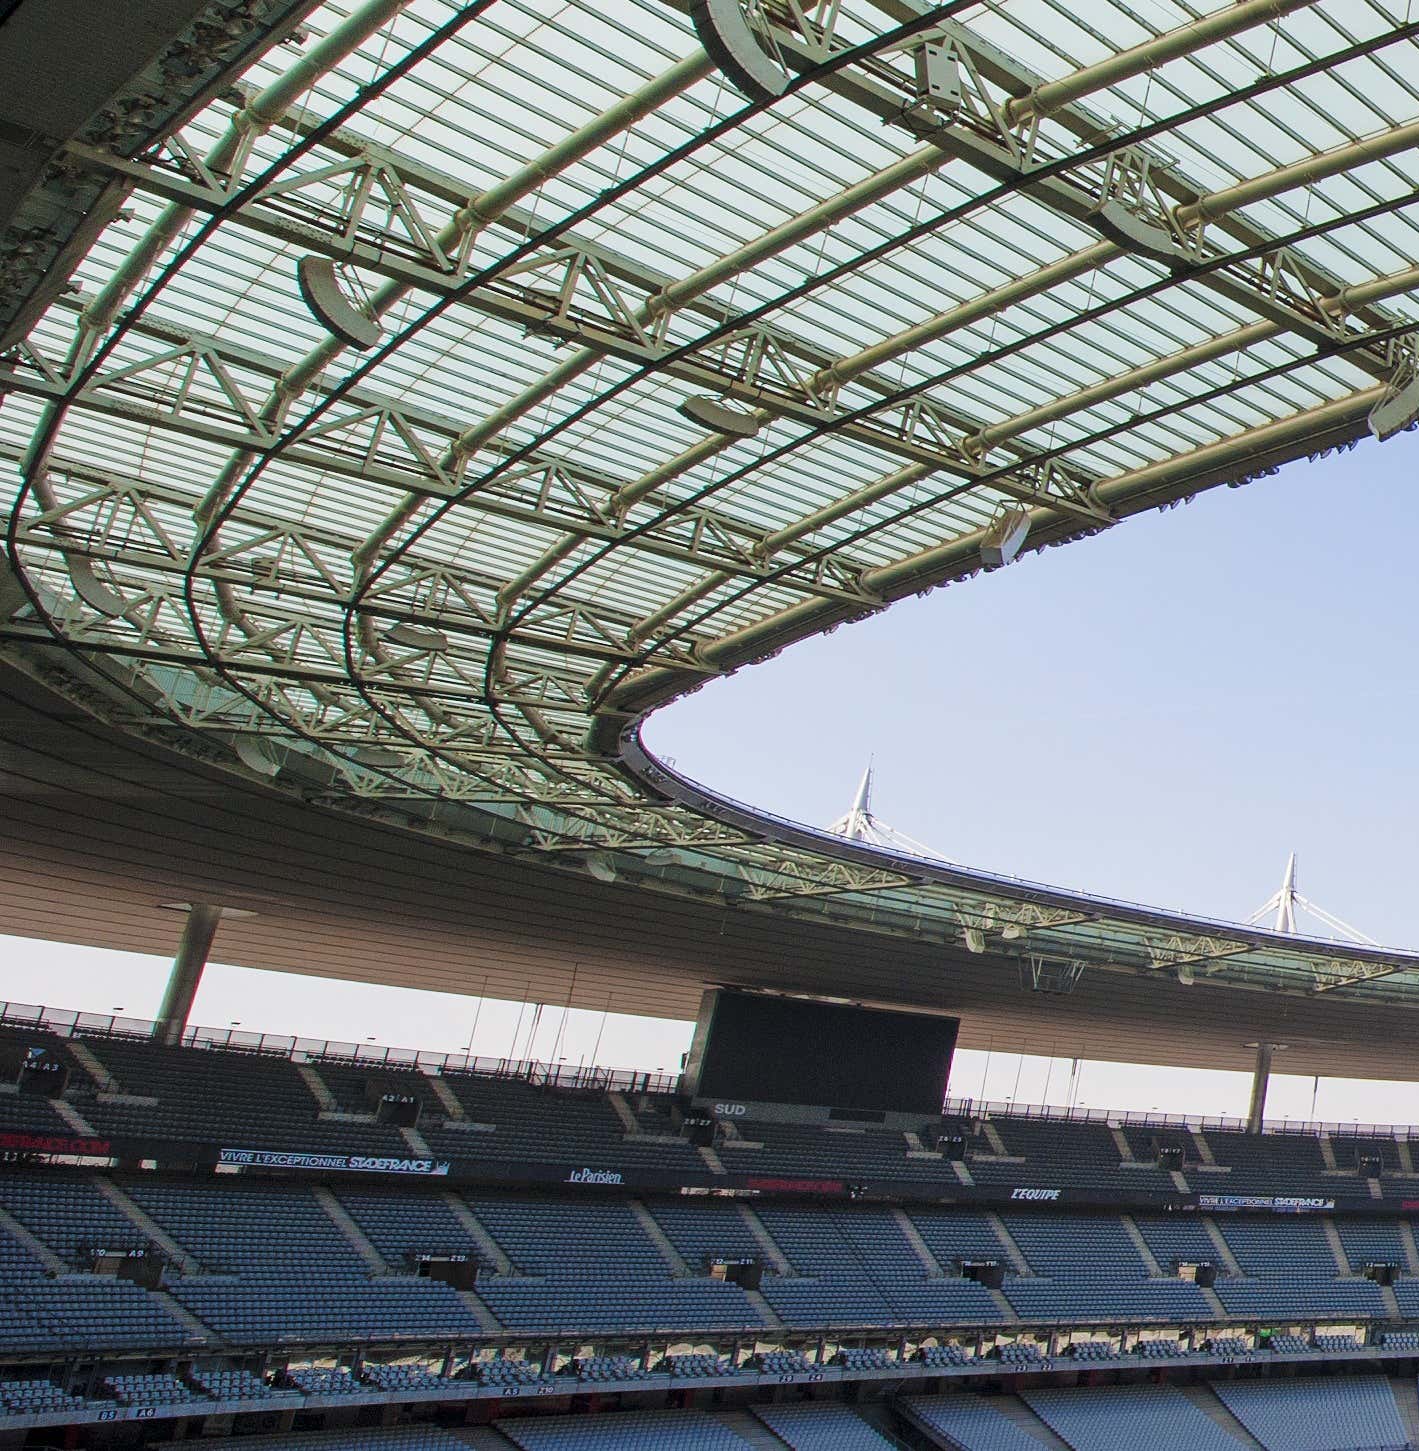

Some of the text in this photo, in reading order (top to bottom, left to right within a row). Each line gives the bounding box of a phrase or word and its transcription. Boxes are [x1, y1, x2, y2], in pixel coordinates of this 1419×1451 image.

[714, 1103, 746, 1115] SUD
[220, 1151, 432, 1172] VIVRE L'EXCEPTIONNEL STADEFRANCE
[582, 1167, 622, 1183] Parisien
[1010, 1188, 1062, 1200] L'EQUIPE
